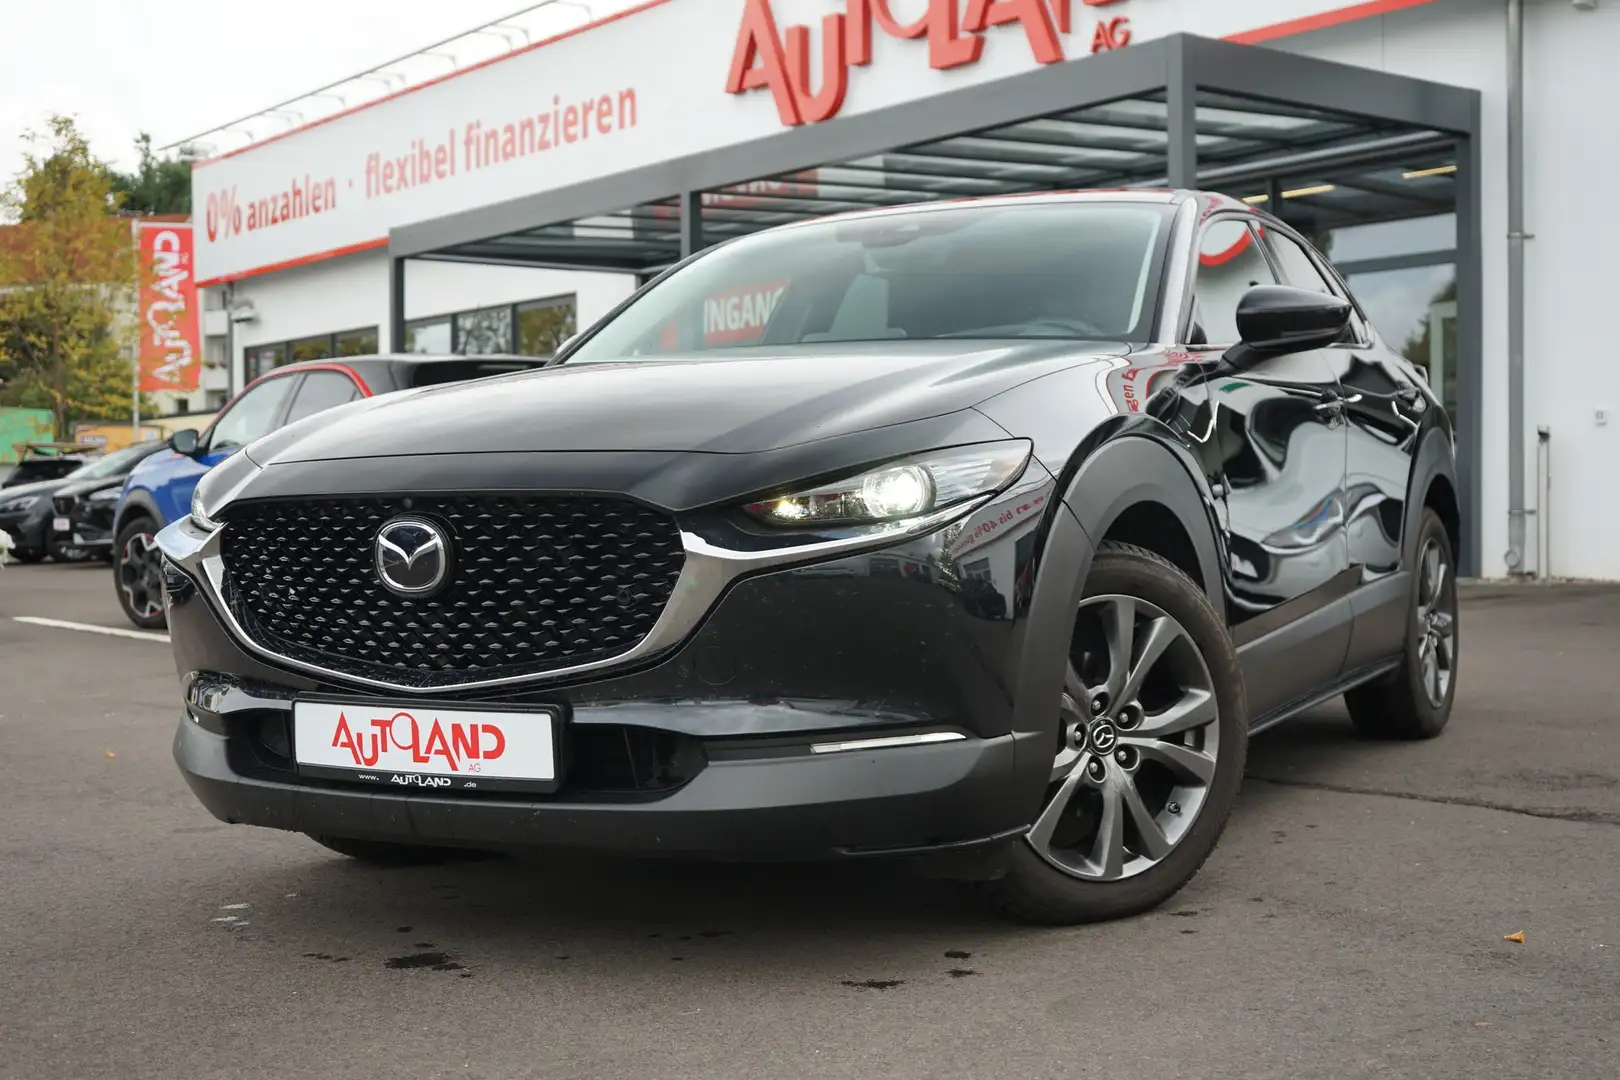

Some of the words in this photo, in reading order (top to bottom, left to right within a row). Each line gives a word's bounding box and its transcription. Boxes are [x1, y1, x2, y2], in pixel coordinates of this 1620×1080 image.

[1090, 15, 1131, 54] AG
[206, 184, 242, 242] 0%
[247, 173, 336, 231] anzahlen
[365, 128, 456, 199] flexibel
[464, 86, 637, 172] finanzieren
[332, 711, 505, 772] AUTOLAND
[391, 774, 451, 787] AUTOLAND
[468, 763, 481, 773] AG
